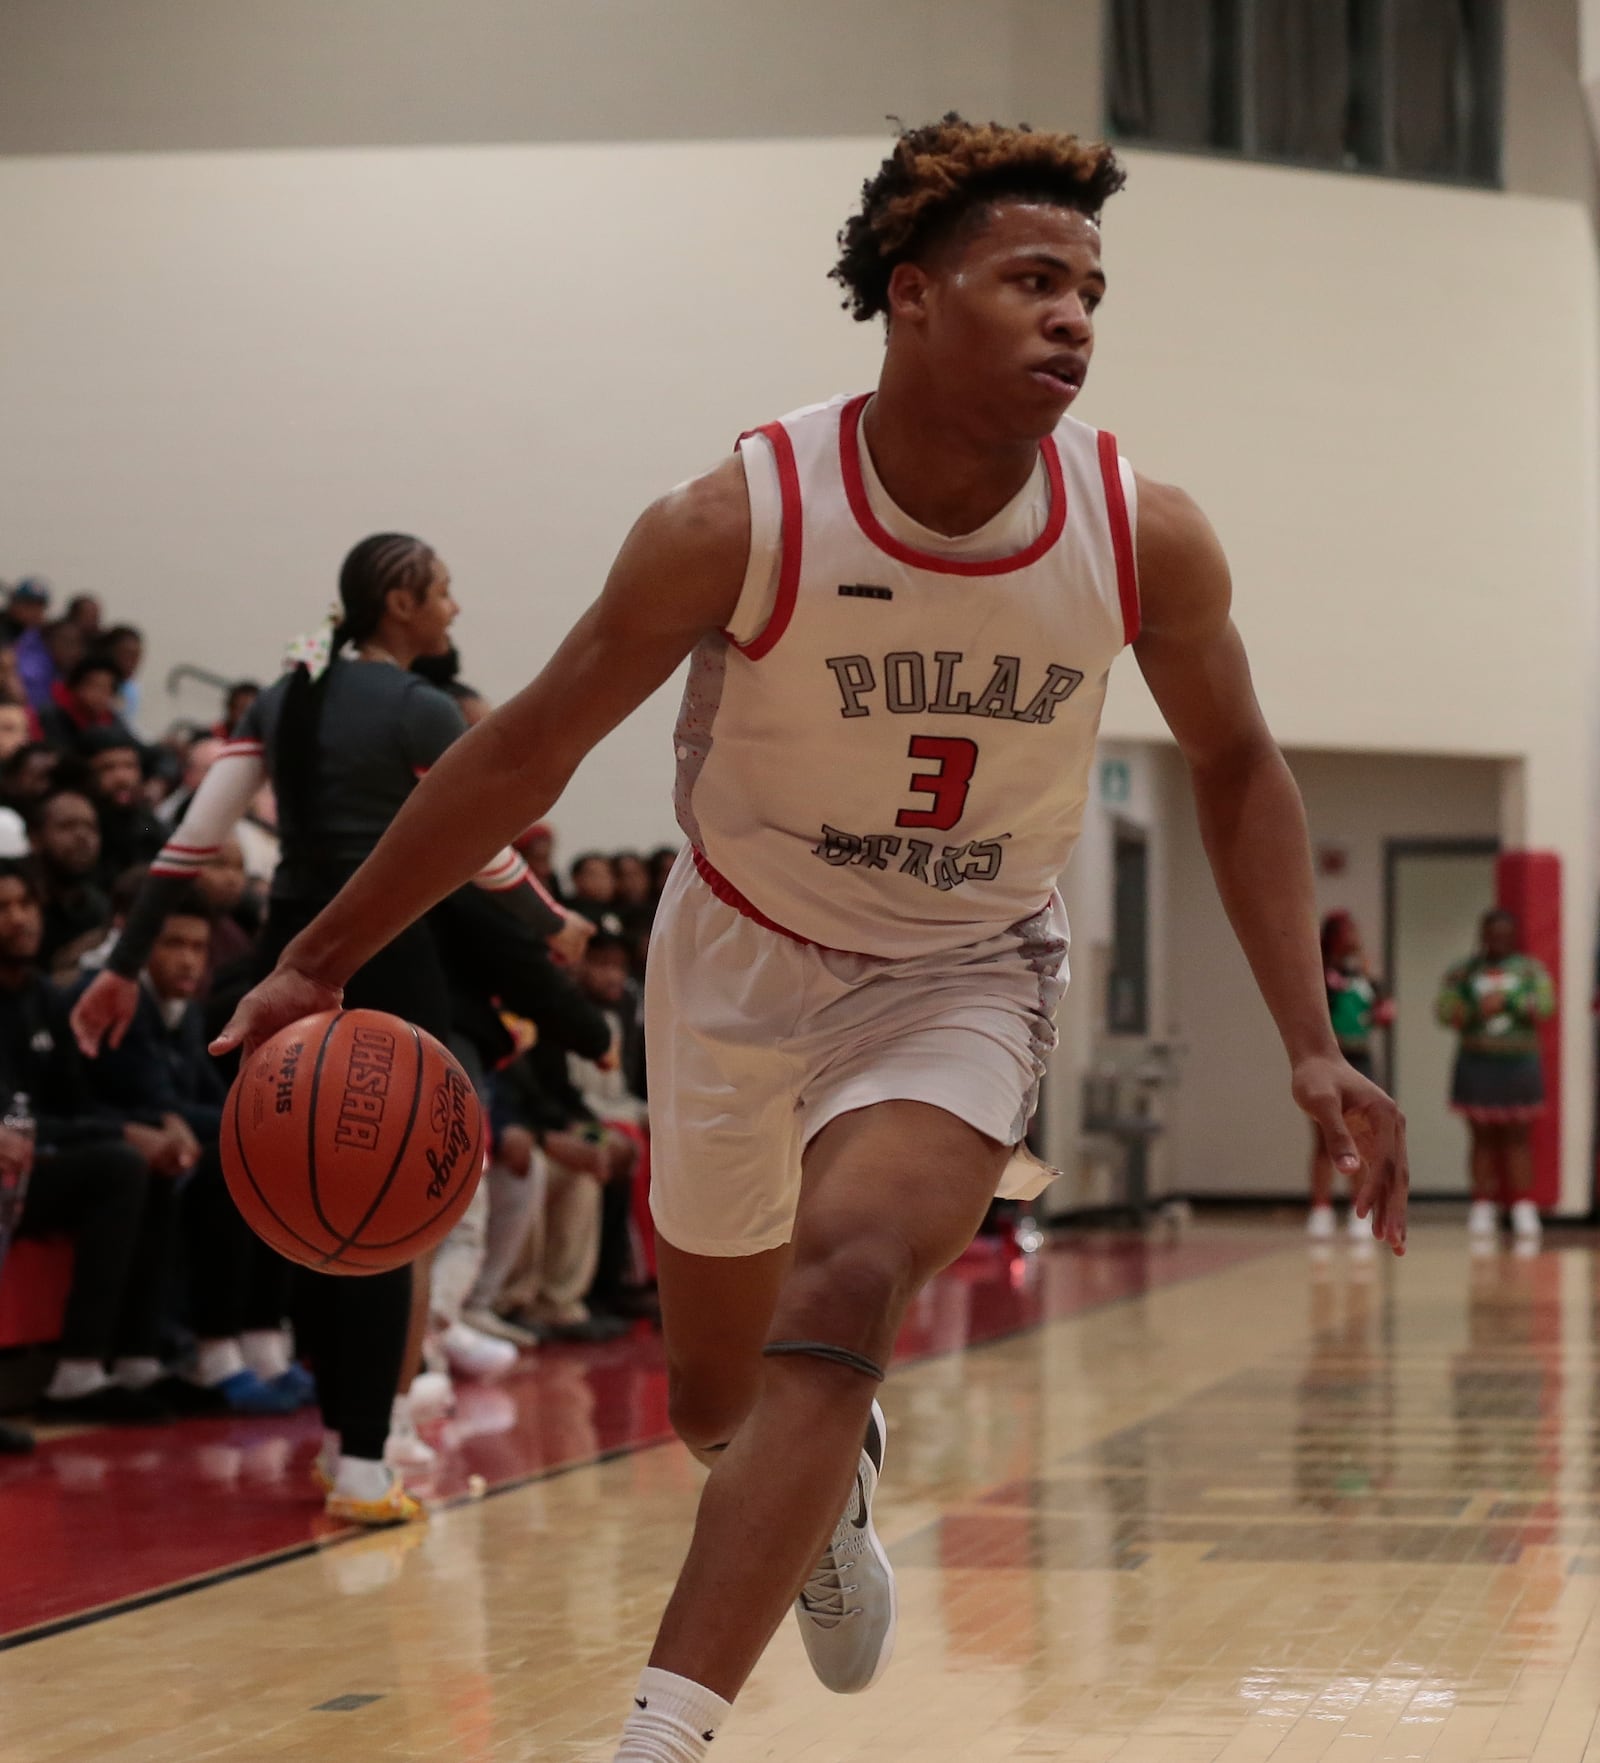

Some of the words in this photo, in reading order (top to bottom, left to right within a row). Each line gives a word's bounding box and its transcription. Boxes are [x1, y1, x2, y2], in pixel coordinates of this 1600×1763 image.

[825, 651, 1085, 724] POLAR
[895, 735, 979, 831] 3
[275, 1056, 299, 1115] NFHS
[334, 1027, 396, 1151] OHSAA
[426, 1067, 472, 1200] Rawlings
